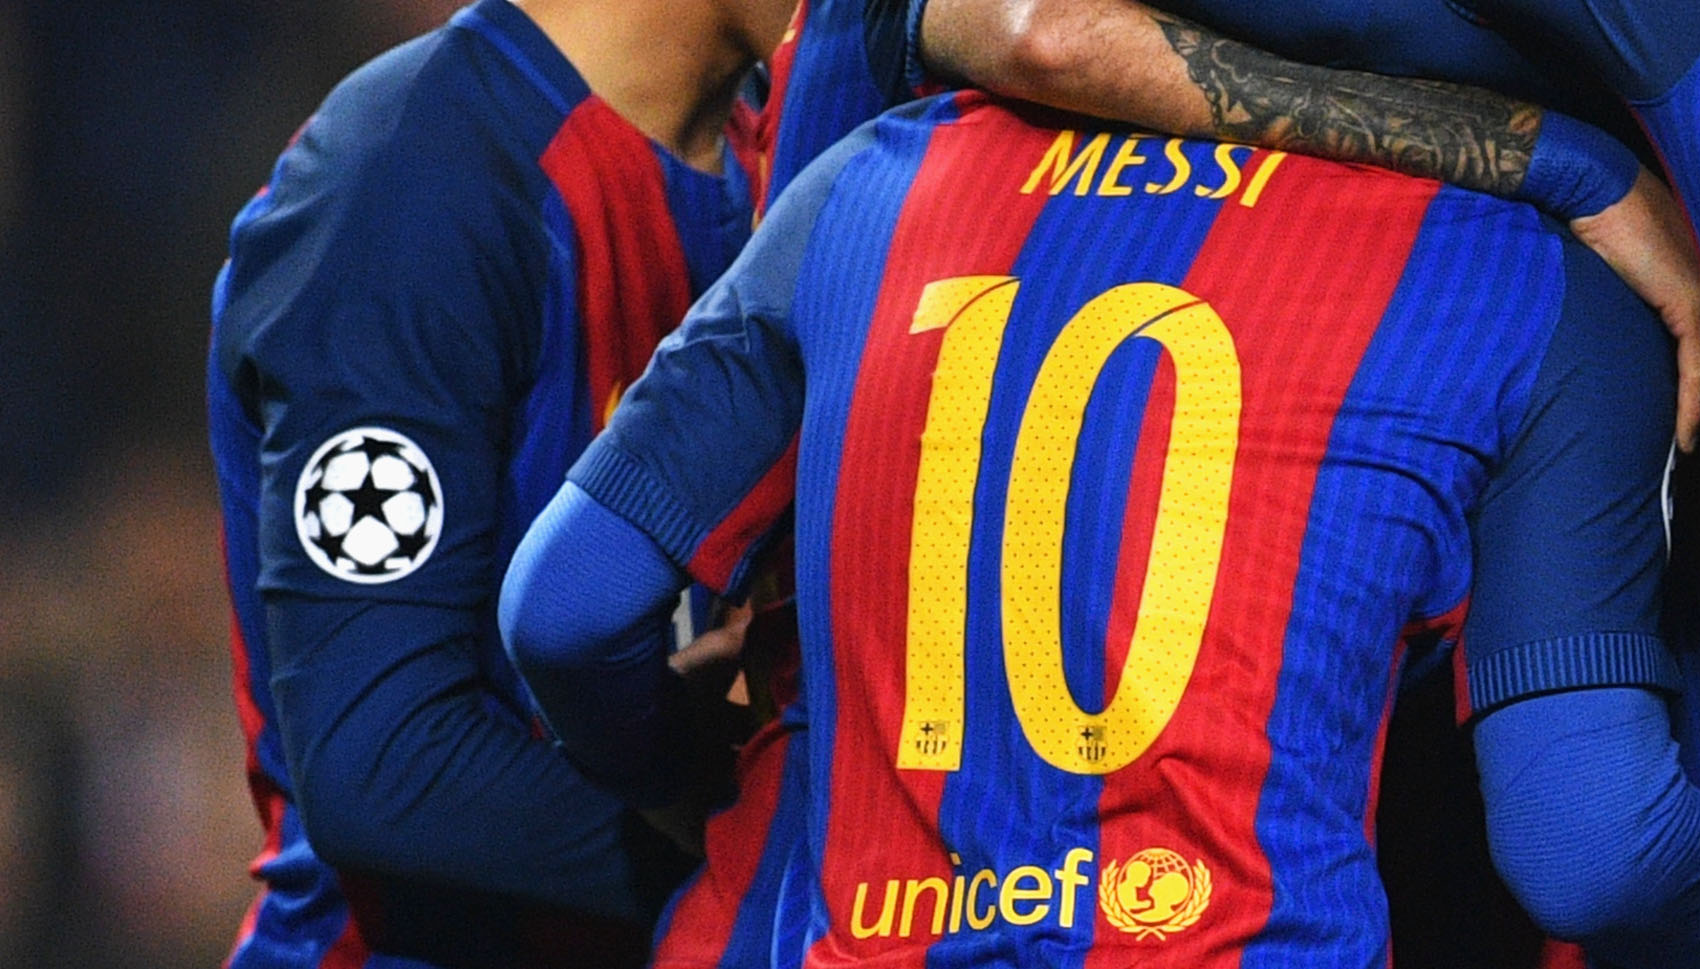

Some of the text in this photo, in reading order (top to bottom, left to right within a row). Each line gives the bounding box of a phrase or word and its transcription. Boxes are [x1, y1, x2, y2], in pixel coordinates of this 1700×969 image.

[1019, 129, 1288, 208] MESSI
[896, 274, 1243, 775] 10
[849, 848, 1093, 940] unicef
